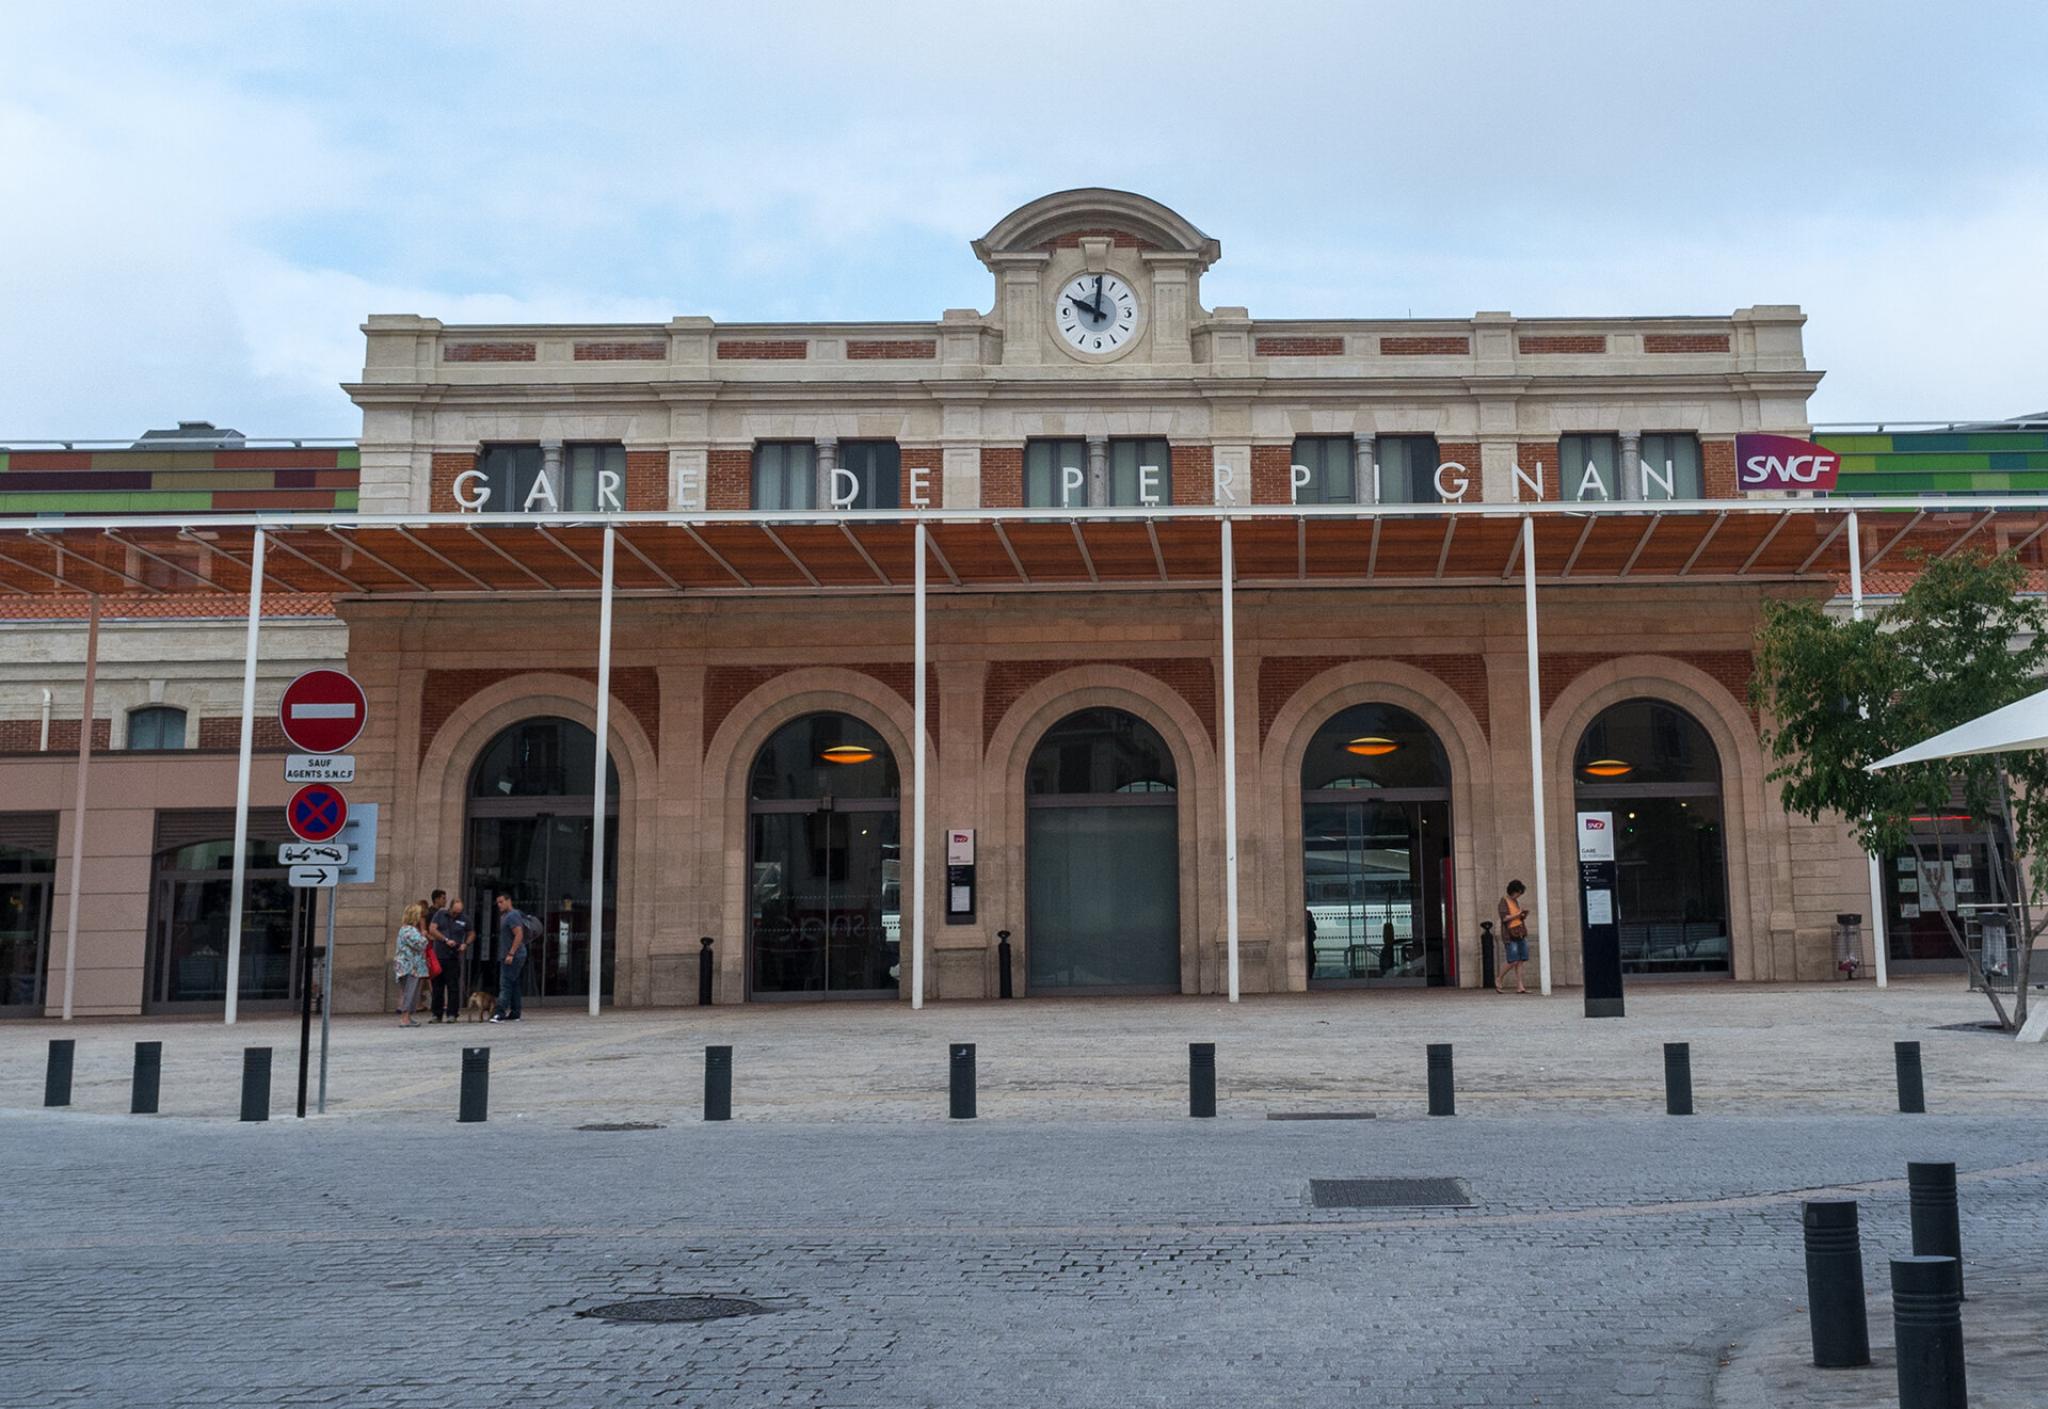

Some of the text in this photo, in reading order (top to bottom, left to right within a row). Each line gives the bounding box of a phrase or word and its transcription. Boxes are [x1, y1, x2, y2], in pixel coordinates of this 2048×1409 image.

[1062, 308, 1071, 319] 9
[1124, 307, 1132, 319] 3
[1093, 337, 1102, 349] 6
[1743, 455, 1835, 483] SNCF
[452, 461, 1675, 510] GARE DE PERPIGNAN
[308, 759, 332, 767] SAUF
[287, 769, 322, 778] AGENTS
